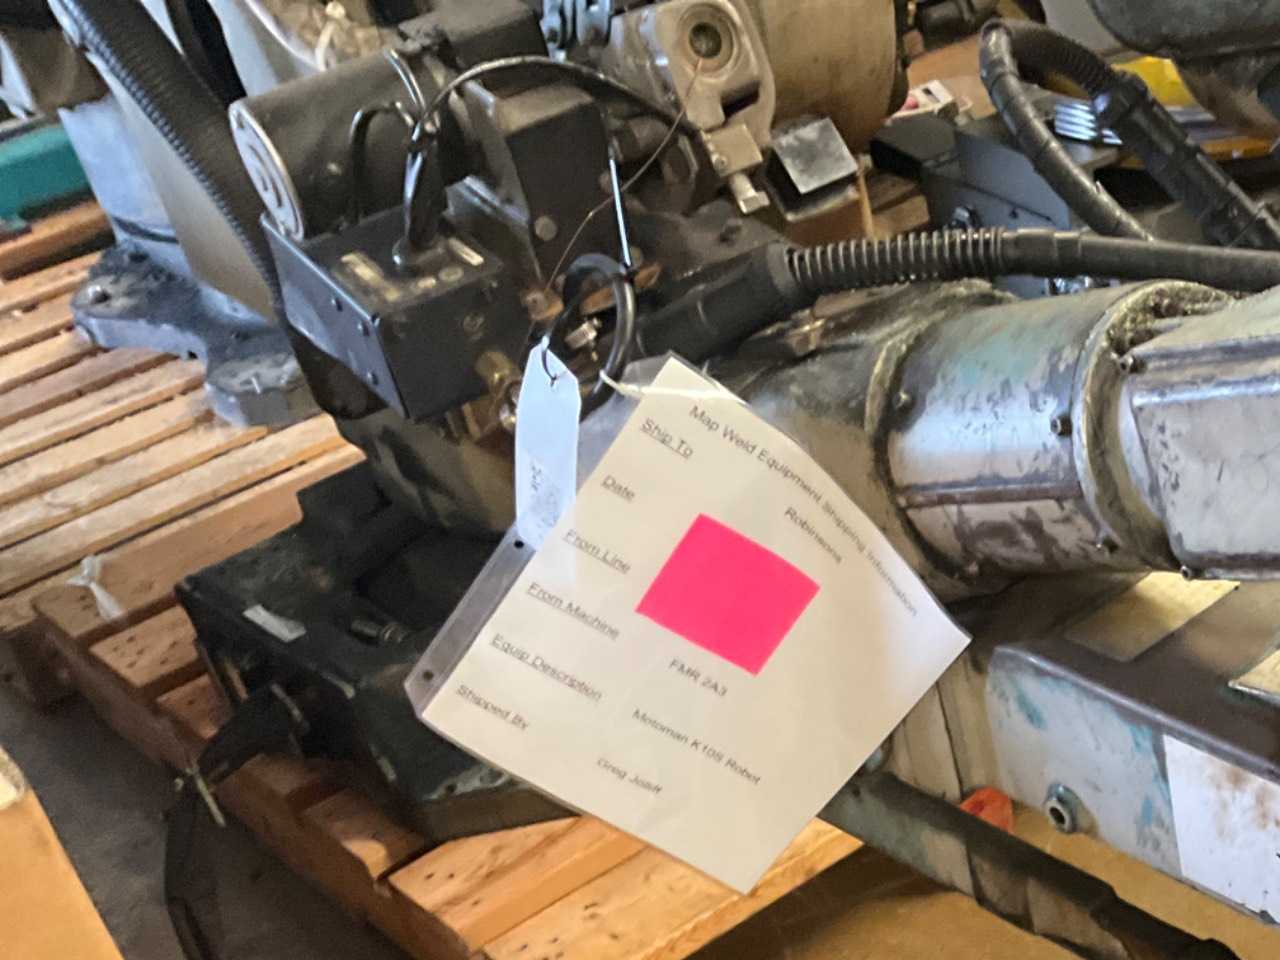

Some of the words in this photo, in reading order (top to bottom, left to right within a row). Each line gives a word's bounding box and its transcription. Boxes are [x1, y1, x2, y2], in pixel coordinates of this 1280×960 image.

[640, 417, 672, 446] Ship
[677, 438, 694, 459] To
[601, 475, 636, 502] Date
[689, 405, 720, 432] Map
[722, 425, 758, 455] Weld
[757, 448, 823, 504] Equipment
[822, 500, 867, 553] Shipping
[866, 550, 918, 617] Information
[563, 529, 602, 561] From
[602, 549, 632, 575] Line
[784, 507, 842, 564] Robinsons
[526, 582, 564, 610] From
[564, 602, 621, 641] Machine
[490, 633, 530, 666] Equip
[530, 655, 602, 702] Description
[669, 659, 701, 682] FMR
[702, 677, 728, 697] 2A3
[456, 684, 511, 723] Shipped
[511, 713, 529, 731] By
[597, 758, 628, 780] Greg
[632, 709, 689, 744] Motoman
[724, 758, 761, 785] Robot
